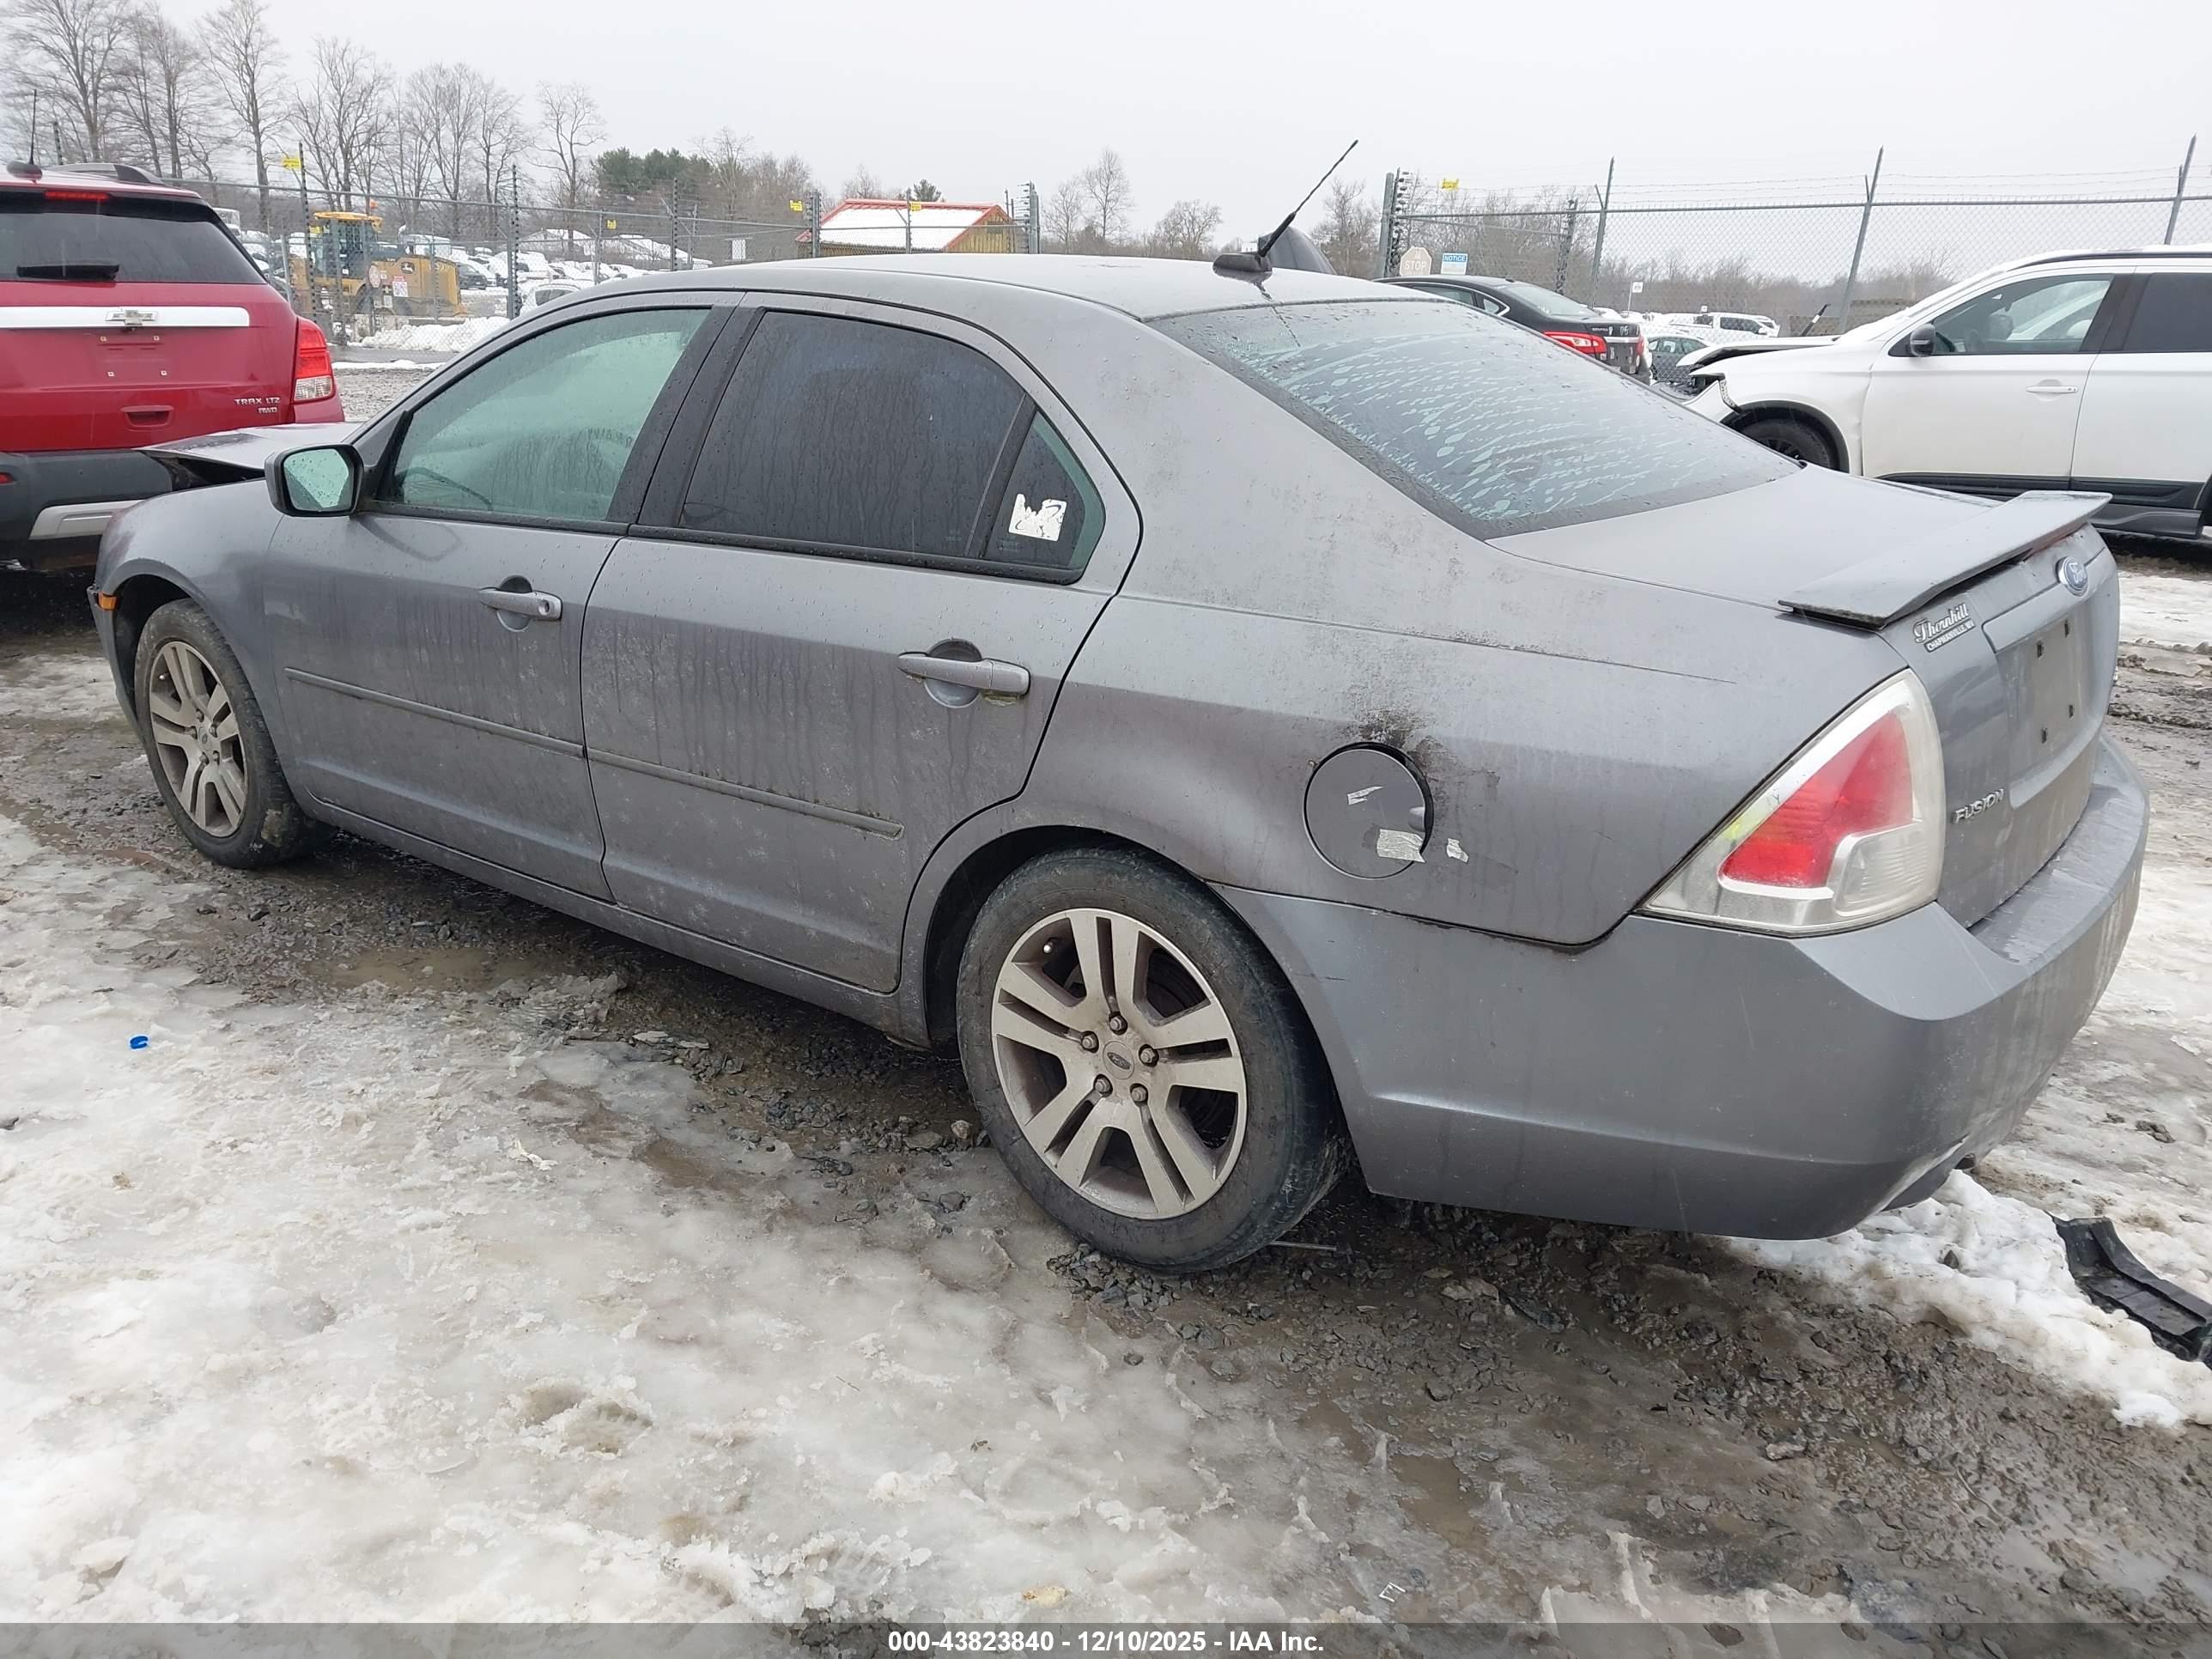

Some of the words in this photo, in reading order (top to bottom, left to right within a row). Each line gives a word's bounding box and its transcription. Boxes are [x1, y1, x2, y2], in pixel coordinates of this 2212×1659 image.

[1404, 260, 1427, 270] STOP
[1912, 603, 1969, 643] Thornhill
[1954, 787, 2005, 824] FUSION
